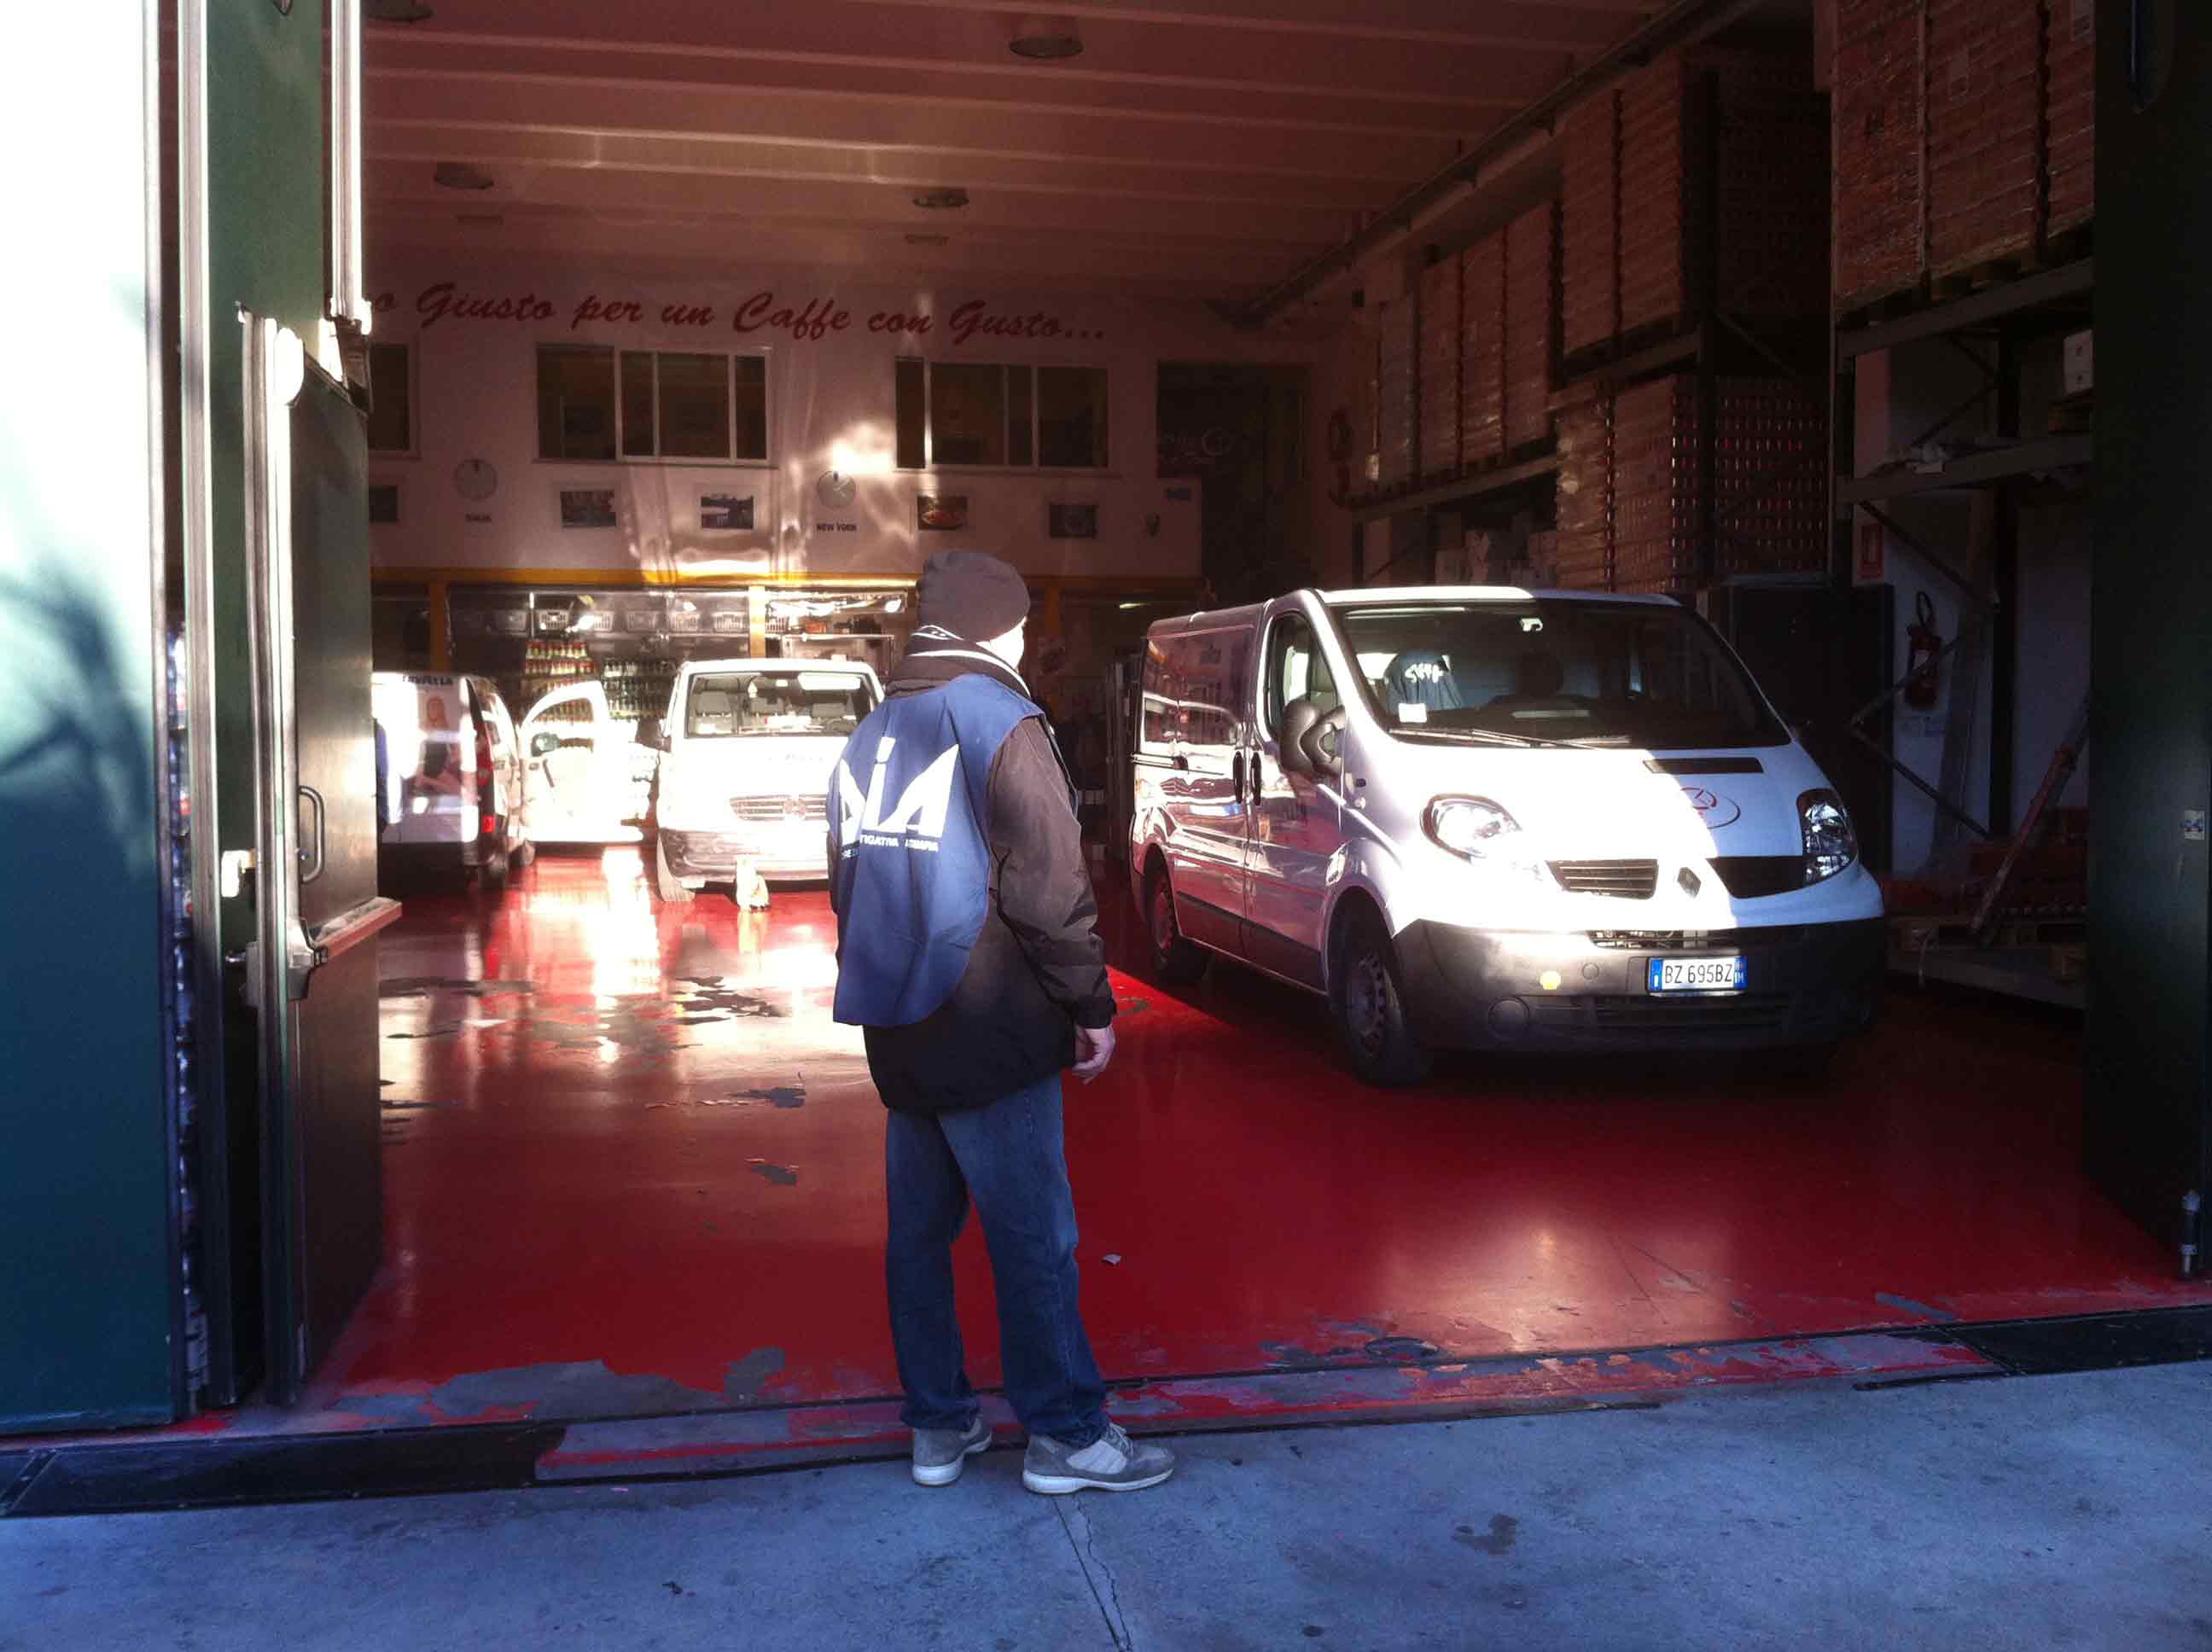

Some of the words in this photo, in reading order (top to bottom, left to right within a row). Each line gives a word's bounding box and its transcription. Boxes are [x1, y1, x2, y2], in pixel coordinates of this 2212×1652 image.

[416, 282, 554, 328] Giusto
[571, 295, 644, 329] per
[661, 305, 715, 326] un
[867, 308, 935, 334] con
[949, 300, 1106, 345] Gusto...
[816, 522, 835, 532] NEW
[835, 521, 858, 532] YORK
[1665, 965, 1683, 984] BZ
[1687, 963, 1733, 984] 695BZ
